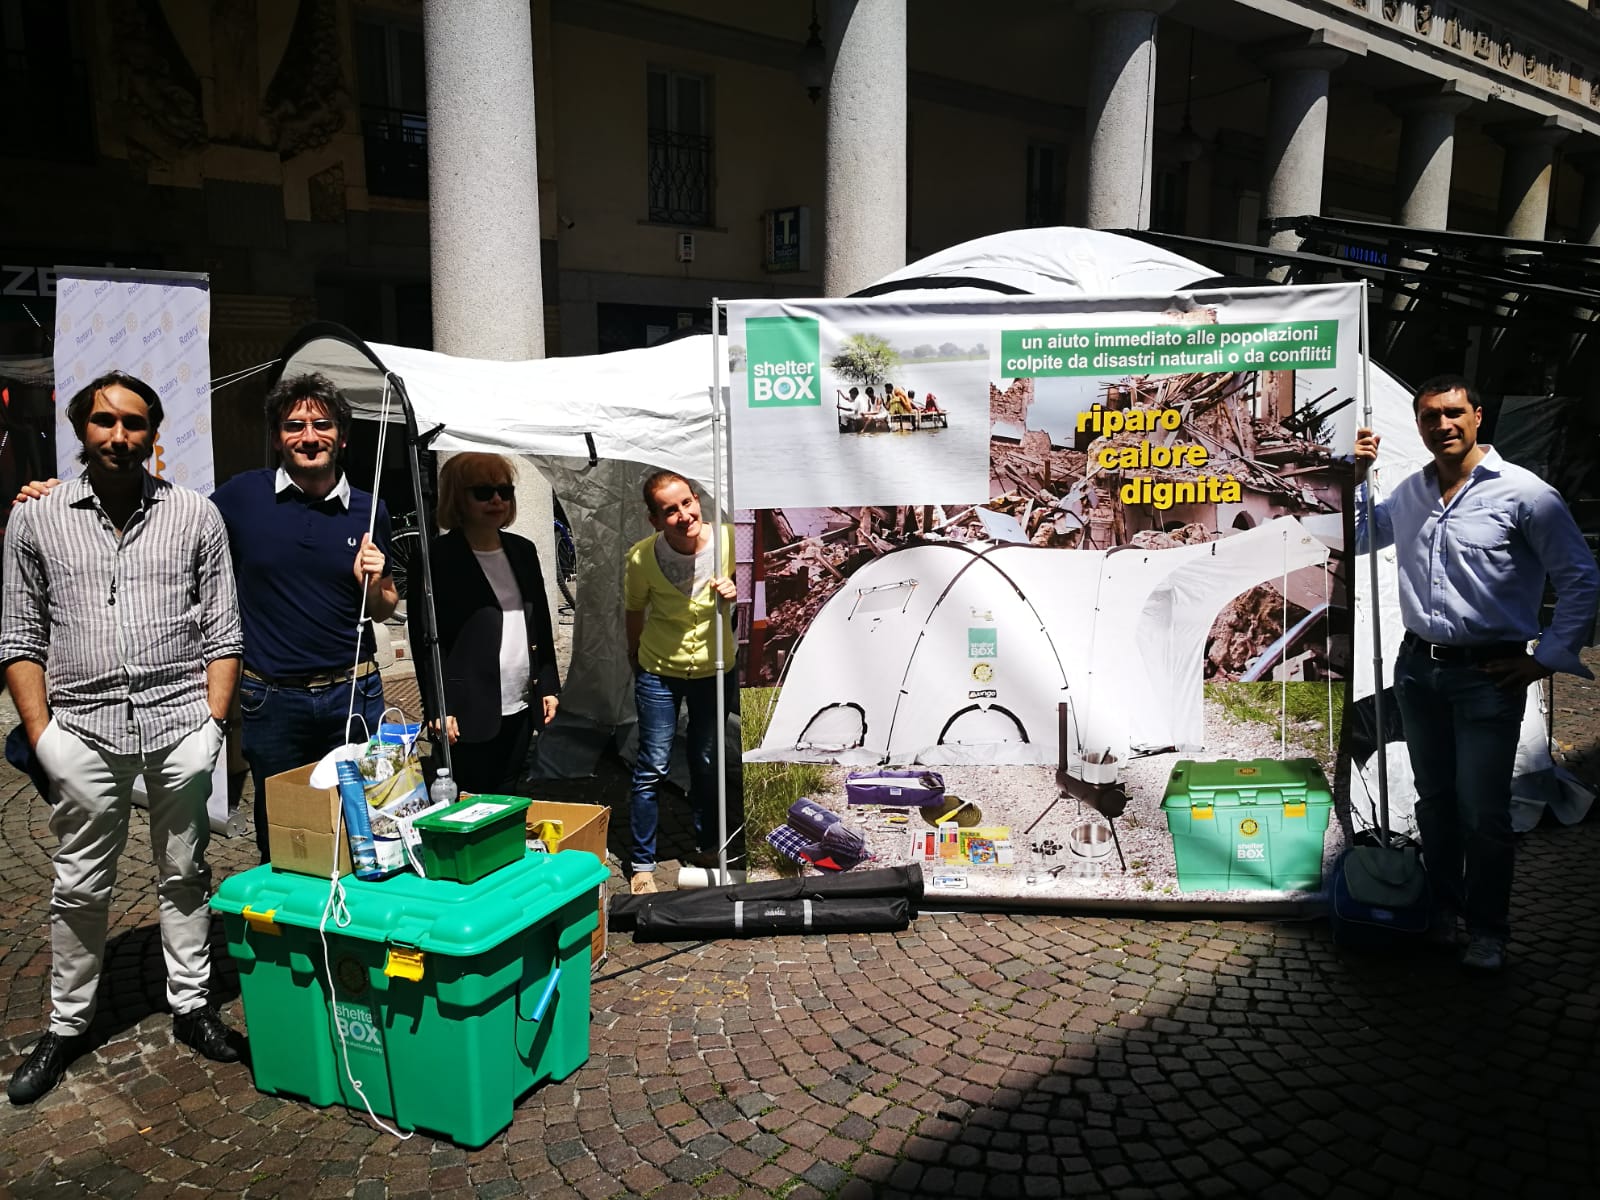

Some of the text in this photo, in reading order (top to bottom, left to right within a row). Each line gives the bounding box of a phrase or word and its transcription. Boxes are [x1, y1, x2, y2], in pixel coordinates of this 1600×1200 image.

[142, 327, 162, 345] Rotary
[178, 326, 199, 345] Rotary
[1022, 325, 1319, 349] un aiuto immediato alle popolazioni
[754, 361, 814, 376] shelter
[1007, 345, 1332, 373] colpite da disastri naturali o da conflitti
[159, 377, 178, 396] Rotary
[754, 376, 815, 400] BOX
[1076, 404, 1182, 438] riparo
[176, 429, 195, 446] Rotary
[1098, 439, 1209, 469] calore
[1120, 474, 1242, 510] dignità
[970, 647, 994, 656] BOX
[1237, 849, 1264, 858] BOX
[337, 1018, 381, 1045] BOX
